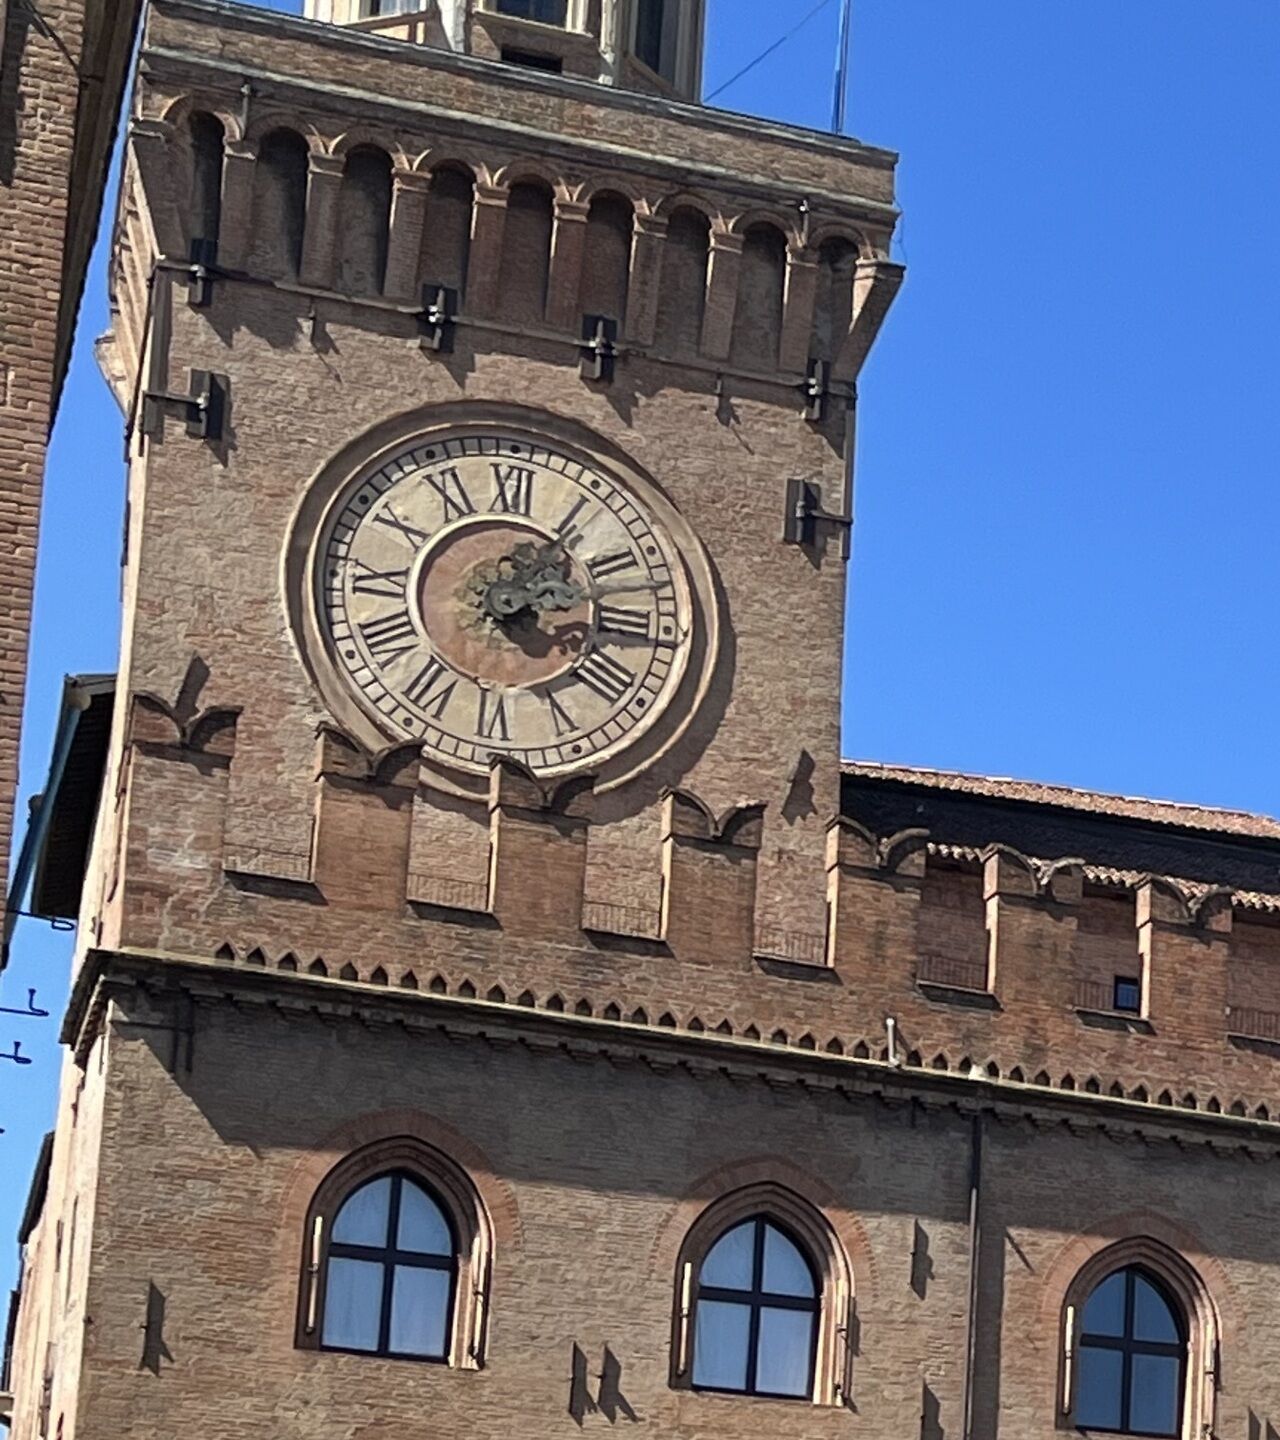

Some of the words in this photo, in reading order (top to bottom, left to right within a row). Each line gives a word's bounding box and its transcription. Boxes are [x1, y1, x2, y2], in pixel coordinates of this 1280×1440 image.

[422, 466, 477, 523] XI
[490, 463, 536, 518] XII
[373, 502, 432, 551] X
[352, 558, 410, 598] IX
[586, 548, 640, 578] II
[357, 608, 420, 671] VIII
[598, 605, 650, 640] III
[402, 655, 459, 721] VII
[476, 685, 512, 741] VI
[545, 687, 579, 737] V
